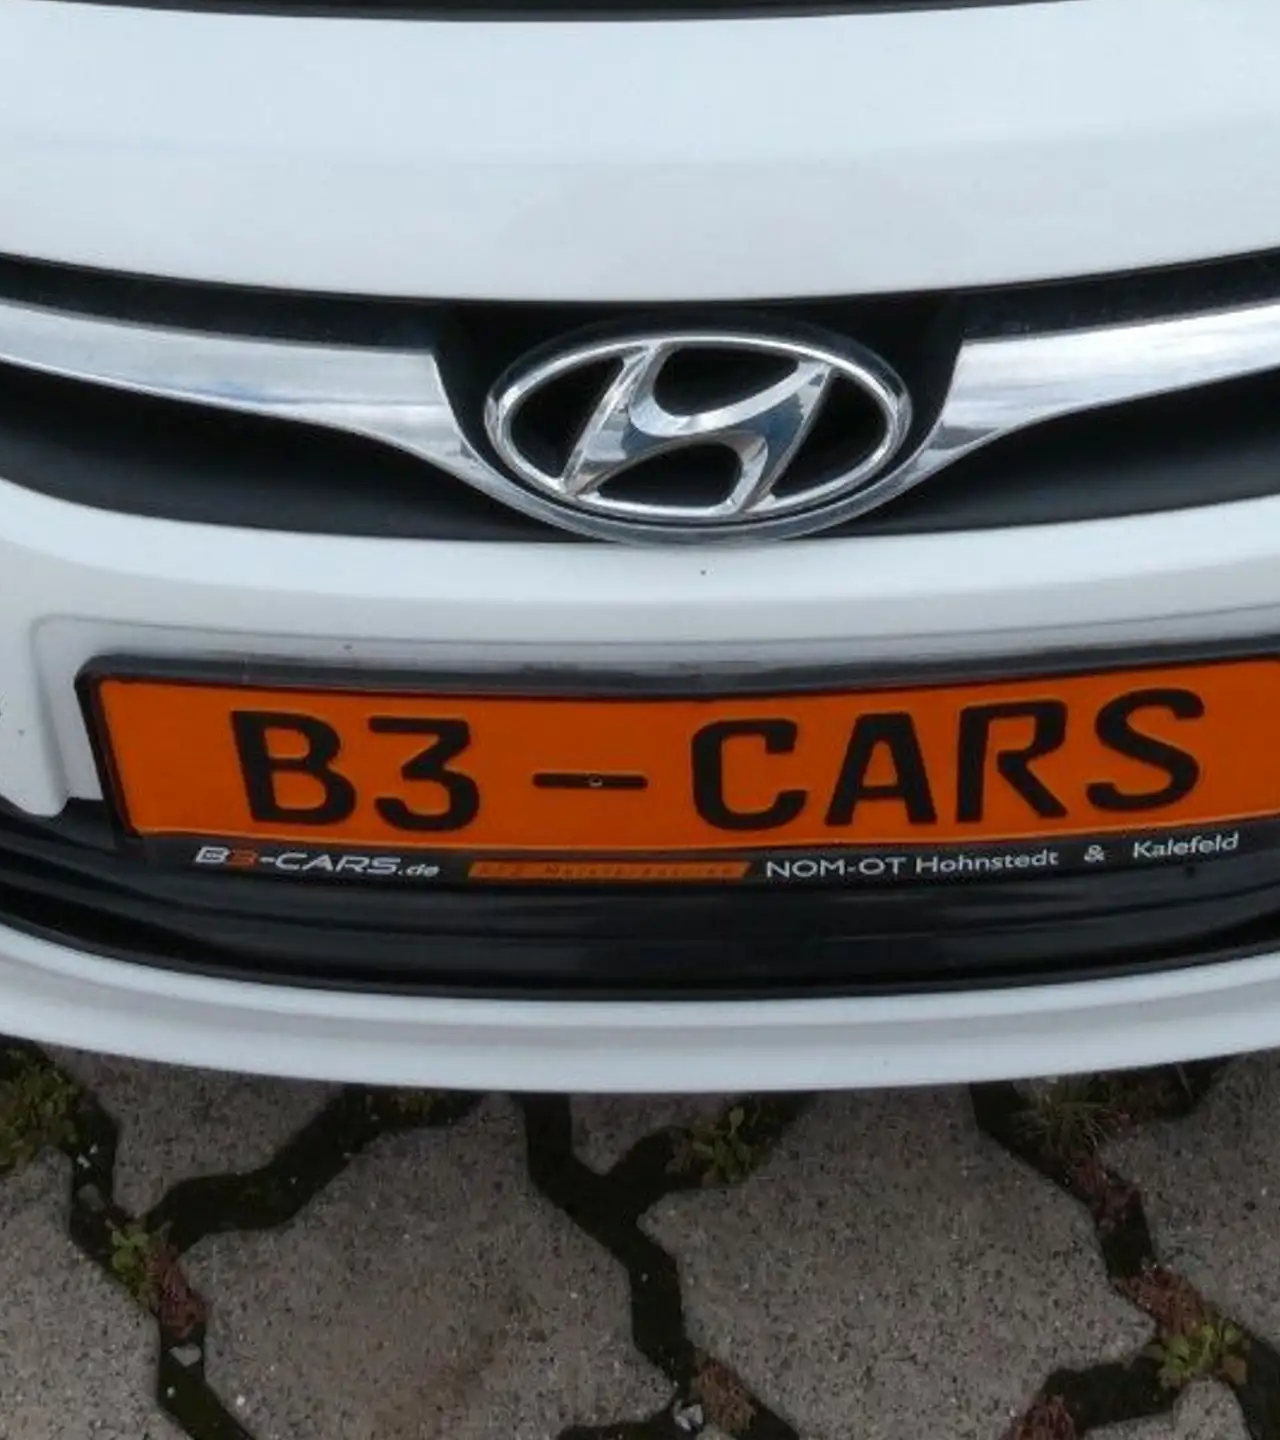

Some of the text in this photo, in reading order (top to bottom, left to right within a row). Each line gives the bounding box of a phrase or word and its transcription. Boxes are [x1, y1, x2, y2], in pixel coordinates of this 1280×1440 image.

[230, 709, 481, 832] B3
[690, 687, 1205, 831] CARS
[195, 845, 440, 878] B3-CARS.de
[765, 856, 907, 878] NOM-OT
[915, 849, 1059, 875] Hohnstedt
[1083, 844, 1106, 863] &
[1132, 832, 1240, 859] Kalefeld
